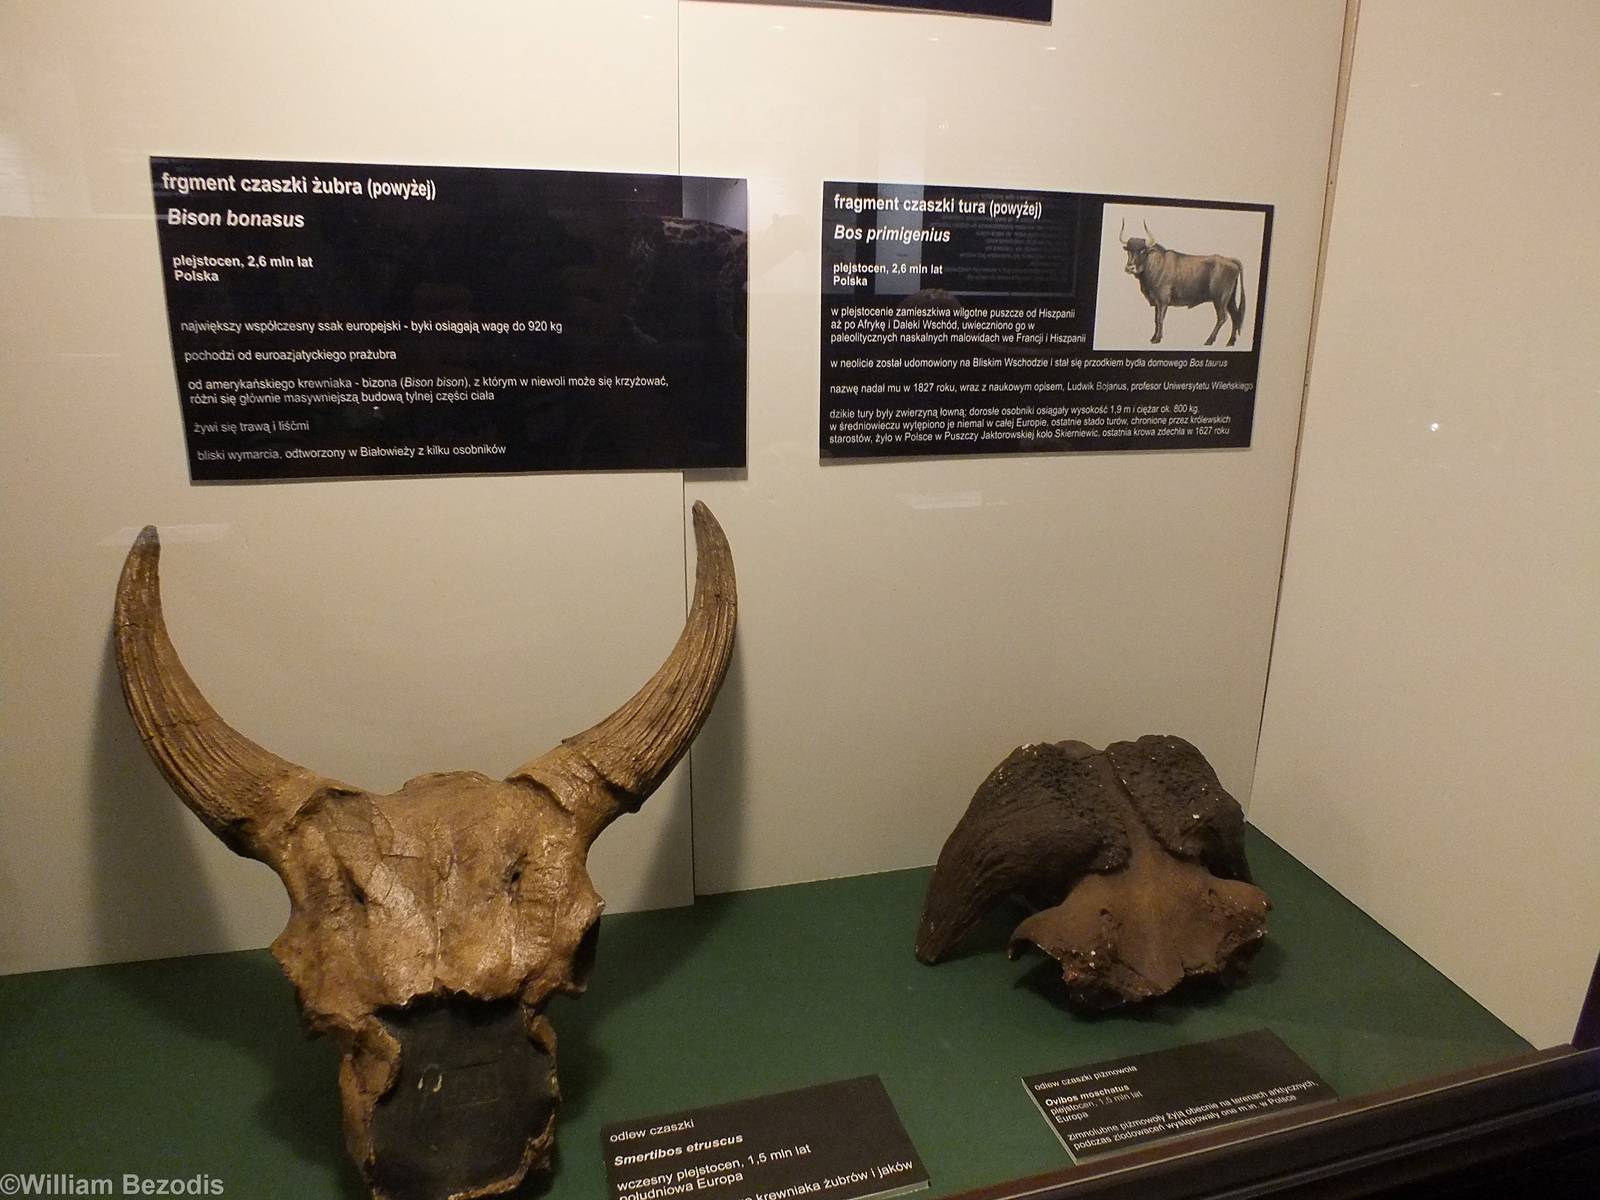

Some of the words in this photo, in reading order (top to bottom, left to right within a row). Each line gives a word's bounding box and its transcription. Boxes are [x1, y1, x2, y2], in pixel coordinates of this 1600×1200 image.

[161, 172, 236, 194] frgment
[240, 175, 307, 193] czaszki
[311, 176, 362, 194] żubra
[367, 177, 435, 200] (powyżej)
[833, 193, 899, 213] fragment
[903, 197, 956, 213] czaszki
[958, 199, 985, 213] tura
[989, 199, 1041, 219] (powyżej)
[167, 208, 221, 225] Bison
[226, 209, 304, 227] bonasus
[833, 223, 862, 239] Bos
[865, 224, 950, 244] primigenius
[246, 255, 266, 267] 2,6
[269, 255, 294, 267] mln
[296, 255, 313, 267] lat
[891, 262, 906, 274] 2,6
[908, 263, 927, 274] mln
[930, 263, 942, 274] lat
[174, 270, 219, 281] Polska
[833, 275, 867, 286] Polska
[840, 305, 893, 318] plejstocenie
[952, 306, 987, 319] wilgotne
[989, 309, 1024, 318] puszcze
[1025, 308, 1036, 318] od
[1038, 308, 1075, 320] Hiszpanii
[180, 320, 241, 334] największy
[244, 320, 315, 333] współczesny
[317, 320, 343, 331] ssak
[345, 320, 400, 333] europejski
[410, 320, 432, 333] byki
[434, 320, 480, 333] osiągają
[481, 322, 509, 333] wagę
[512, 320, 525, 331] do
[527, 320, 547, 331] 920
[549, 320, 562, 333] kg
[857, 319, 885, 331] Afrykę
[892, 319, 920, 329] Daleki
[961, 320, 1013, 330] uwieczniono
[830, 332, 897, 344] paleolitycznych
[899, 332, 948, 344] naskalnych
[1016, 332, 1043, 344] Francji
[1049, 333, 1086, 344] Hiszpanii
[184, 349, 235, 362] pochodzi
[237, 349, 252, 360] od
[254, 349, 346, 362] euroazjatyckiego
[348, 349, 396, 361] prażubra
[840, 358, 873, 368] neolicie
[875, 358, 901, 367] został
[904, 358, 957, 369] udomowiony
[972, 358, 1001, 367] Bliskim
[1004, 358, 1048, 367] Wschodzie
[1054, 358, 1069, 367] stał
[1070, 358, 1082, 368] się
[1083, 358, 1123, 368] przodkiem
[1125, 358, 1145, 368] bydła
[1147, 358, 1188, 369] domowego
[187, 379, 202, 389] od
[205, 378, 295, 391] amerykańskiego
[297, 378, 352, 388] krewniaka
[361, 377, 397, 387] bizona
[400, 377, 433, 389] (Bison
[482, 376, 517, 388] którym
[530, 376, 565, 386] niewoli
[568, 376, 595, 386] może
[598, 375, 612, 388] się
[189, 393, 217, 404] różni
[219, 393, 236, 406] się
[239, 392, 280, 406] głównie
[283, 392, 360, 405] masywniejszą
[360, 391, 404, 403] budową
[405, 390, 433, 403] tylnej
[435, 390, 468, 403] części
[470, 390, 494, 400] ciała
[193, 421, 218, 434] żywi
[220, 423, 237, 434] się
[239, 422, 271, 433] trawą
[278, 420, 309, 431] liśćmi
[196, 449, 225, 460] bliski
[284, 448, 345, 459] odtworzony
[360, 445, 415, 458] Białowieży
[426, 444, 449, 455] kilku
[452, 443, 506, 454] osobników
[609, 1129, 646, 1142] odlew
[649, 1118, 694, 1135] czaszki
[614, 1146, 682, 1166] Smertibos
[686, 1134, 742, 1152] etruscus
[616, 1172, 673, 1192] wczesny
[747, 1152, 766, 1164] 1,5
[769, 1148, 792, 1160] mln
[794, 1143, 811, 1155] lat
[756, 1182, 821, 1200] krewniaka
[824, 1171, 868, 1189] żubrów
[878, 1160, 913, 1178] jaków
